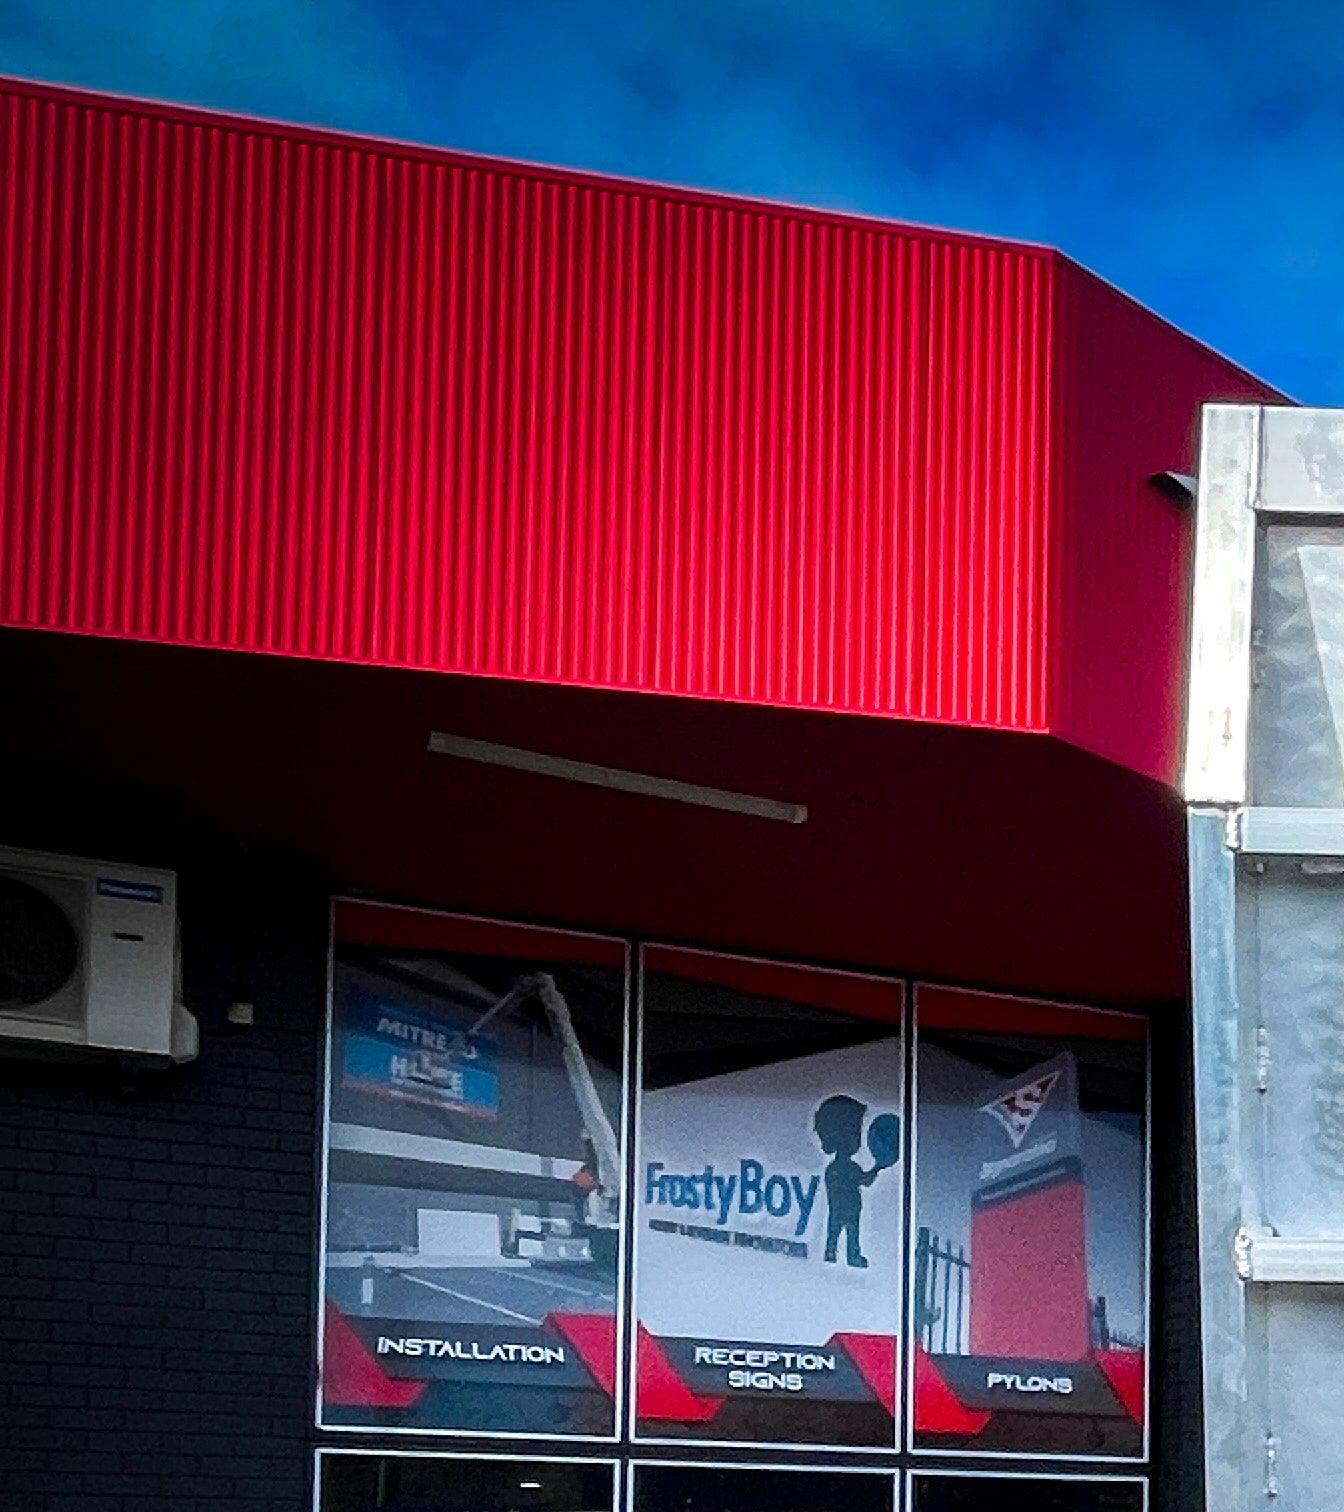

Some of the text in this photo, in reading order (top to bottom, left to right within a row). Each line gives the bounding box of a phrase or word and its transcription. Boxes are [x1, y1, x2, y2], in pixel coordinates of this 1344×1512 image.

[377, 1336, 565, 1363] INSTALLATION
[695, 1347, 835, 1370] RECEPTION
[728, 1370, 803, 1390] SIGNS
[987, 1372, 1073, 1394] PYLONS
